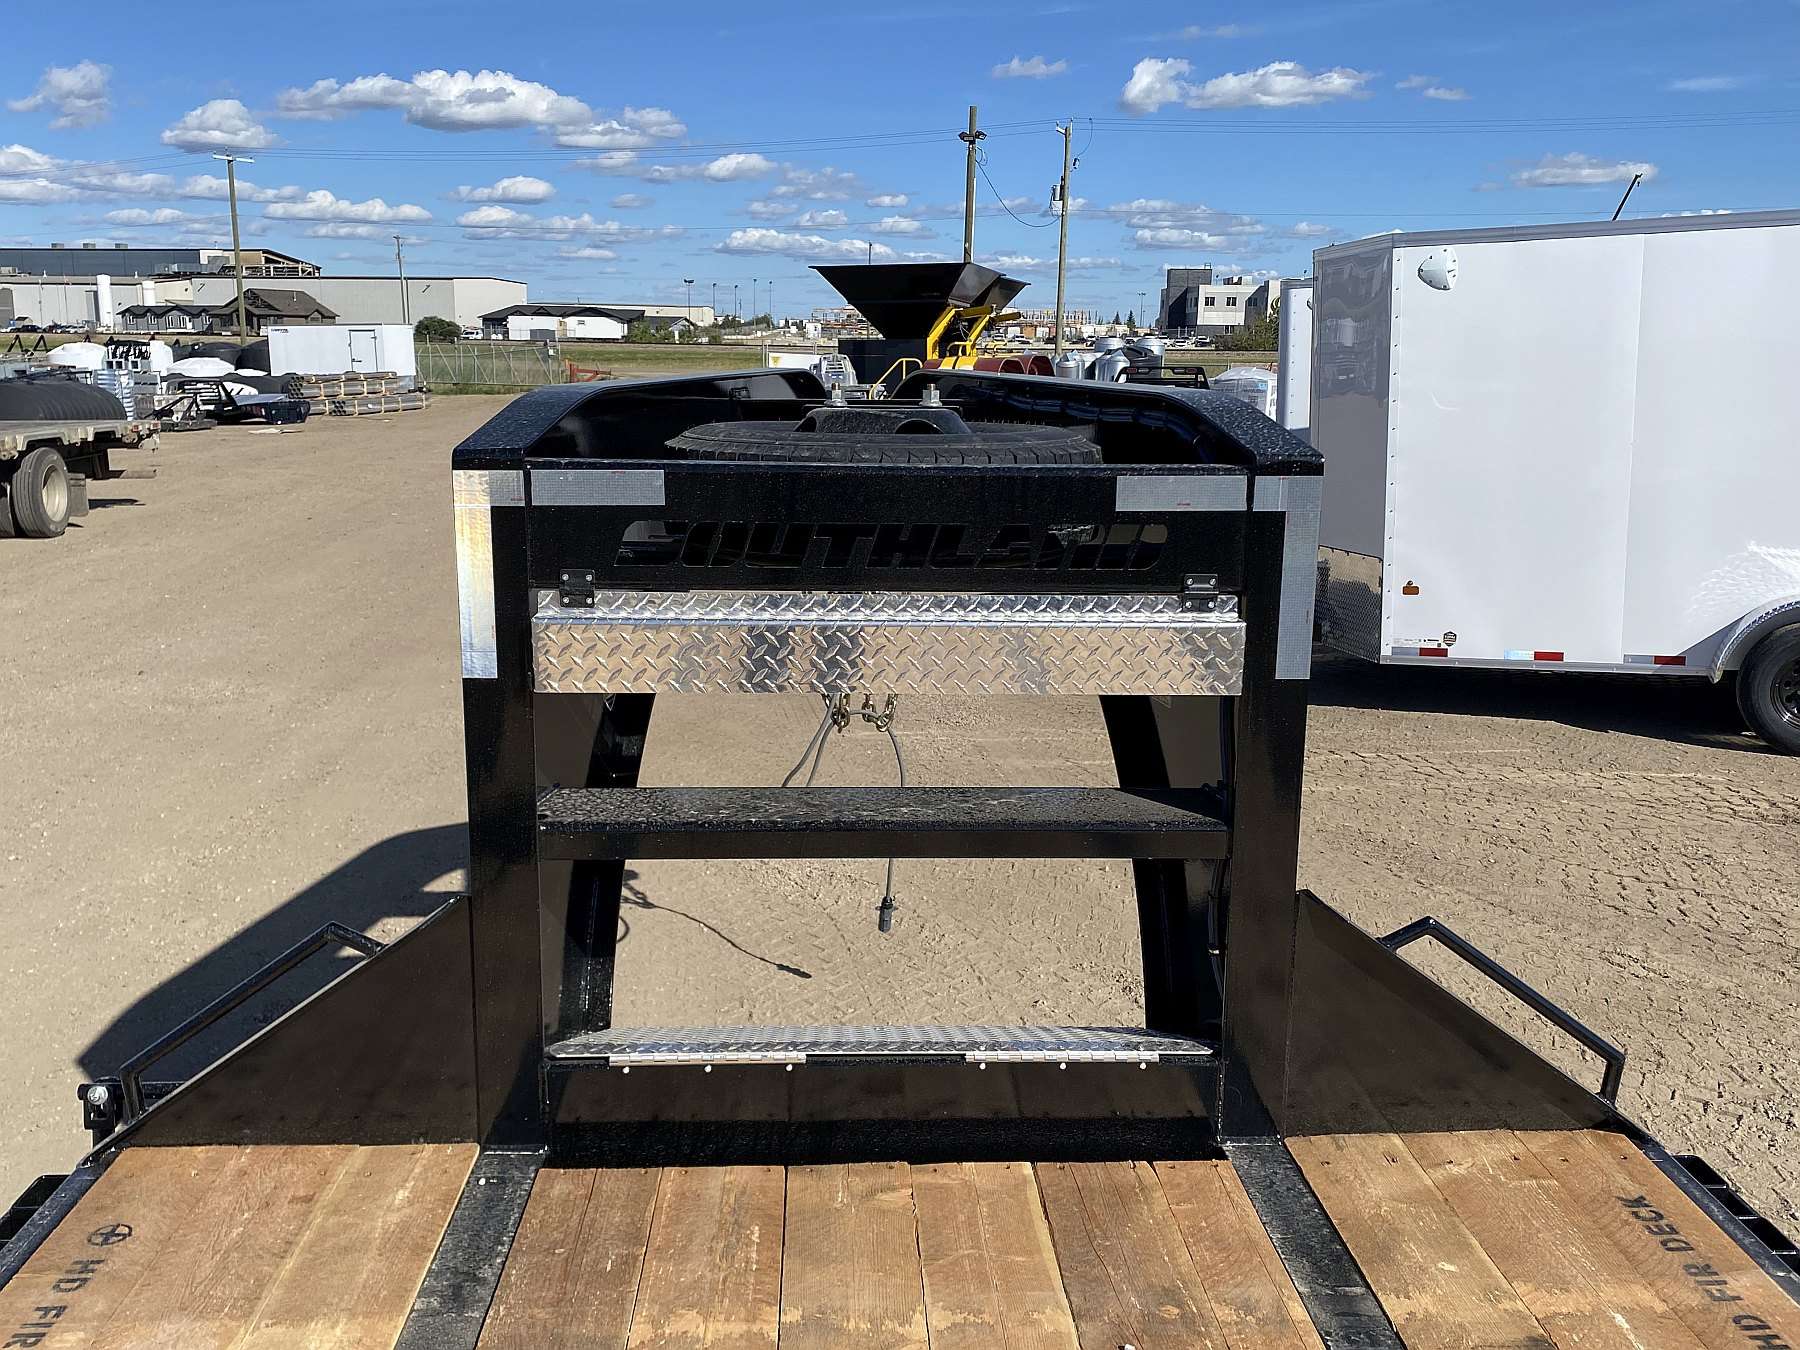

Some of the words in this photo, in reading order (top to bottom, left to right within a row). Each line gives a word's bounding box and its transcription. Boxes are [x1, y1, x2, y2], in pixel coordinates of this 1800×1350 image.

[613, 520, 1168, 571] SOUTHLAND
[1614, 1195, 1695, 1252] DECK
[52, 1259, 106, 1293] HD
[1682, 1263, 1744, 1302] FIR
[2, 1305, 68, 1349] FIR
[1731, 1314, 1793, 1350] HD
